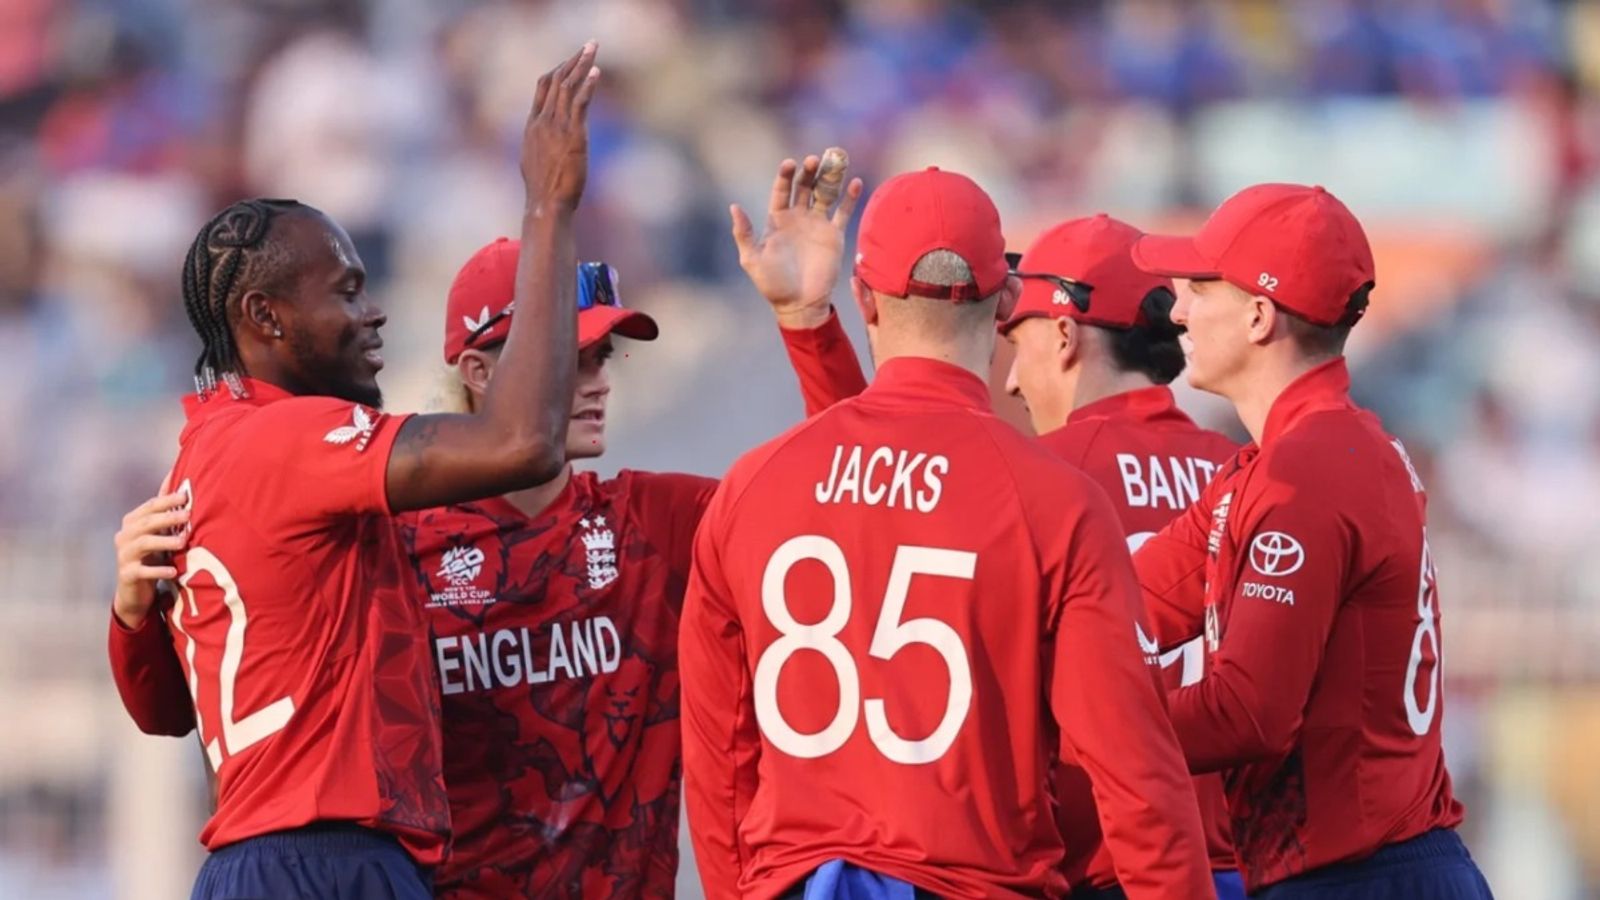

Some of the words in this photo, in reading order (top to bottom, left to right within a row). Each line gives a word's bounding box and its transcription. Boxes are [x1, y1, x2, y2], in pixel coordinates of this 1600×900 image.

[1257, 272, 1278, 292] 92
[815, 445, 948, 512] JACKS
[1116, 453, 1224, 510] BANT
[430, 591, 468, 602] WORLD
[469, 590, 490, 599] CUP
[1242, 582, 1294, 606] TOYOTA
[435, 616, 621, 695] ENGLAND
[753, 534, 978, 764] 85
